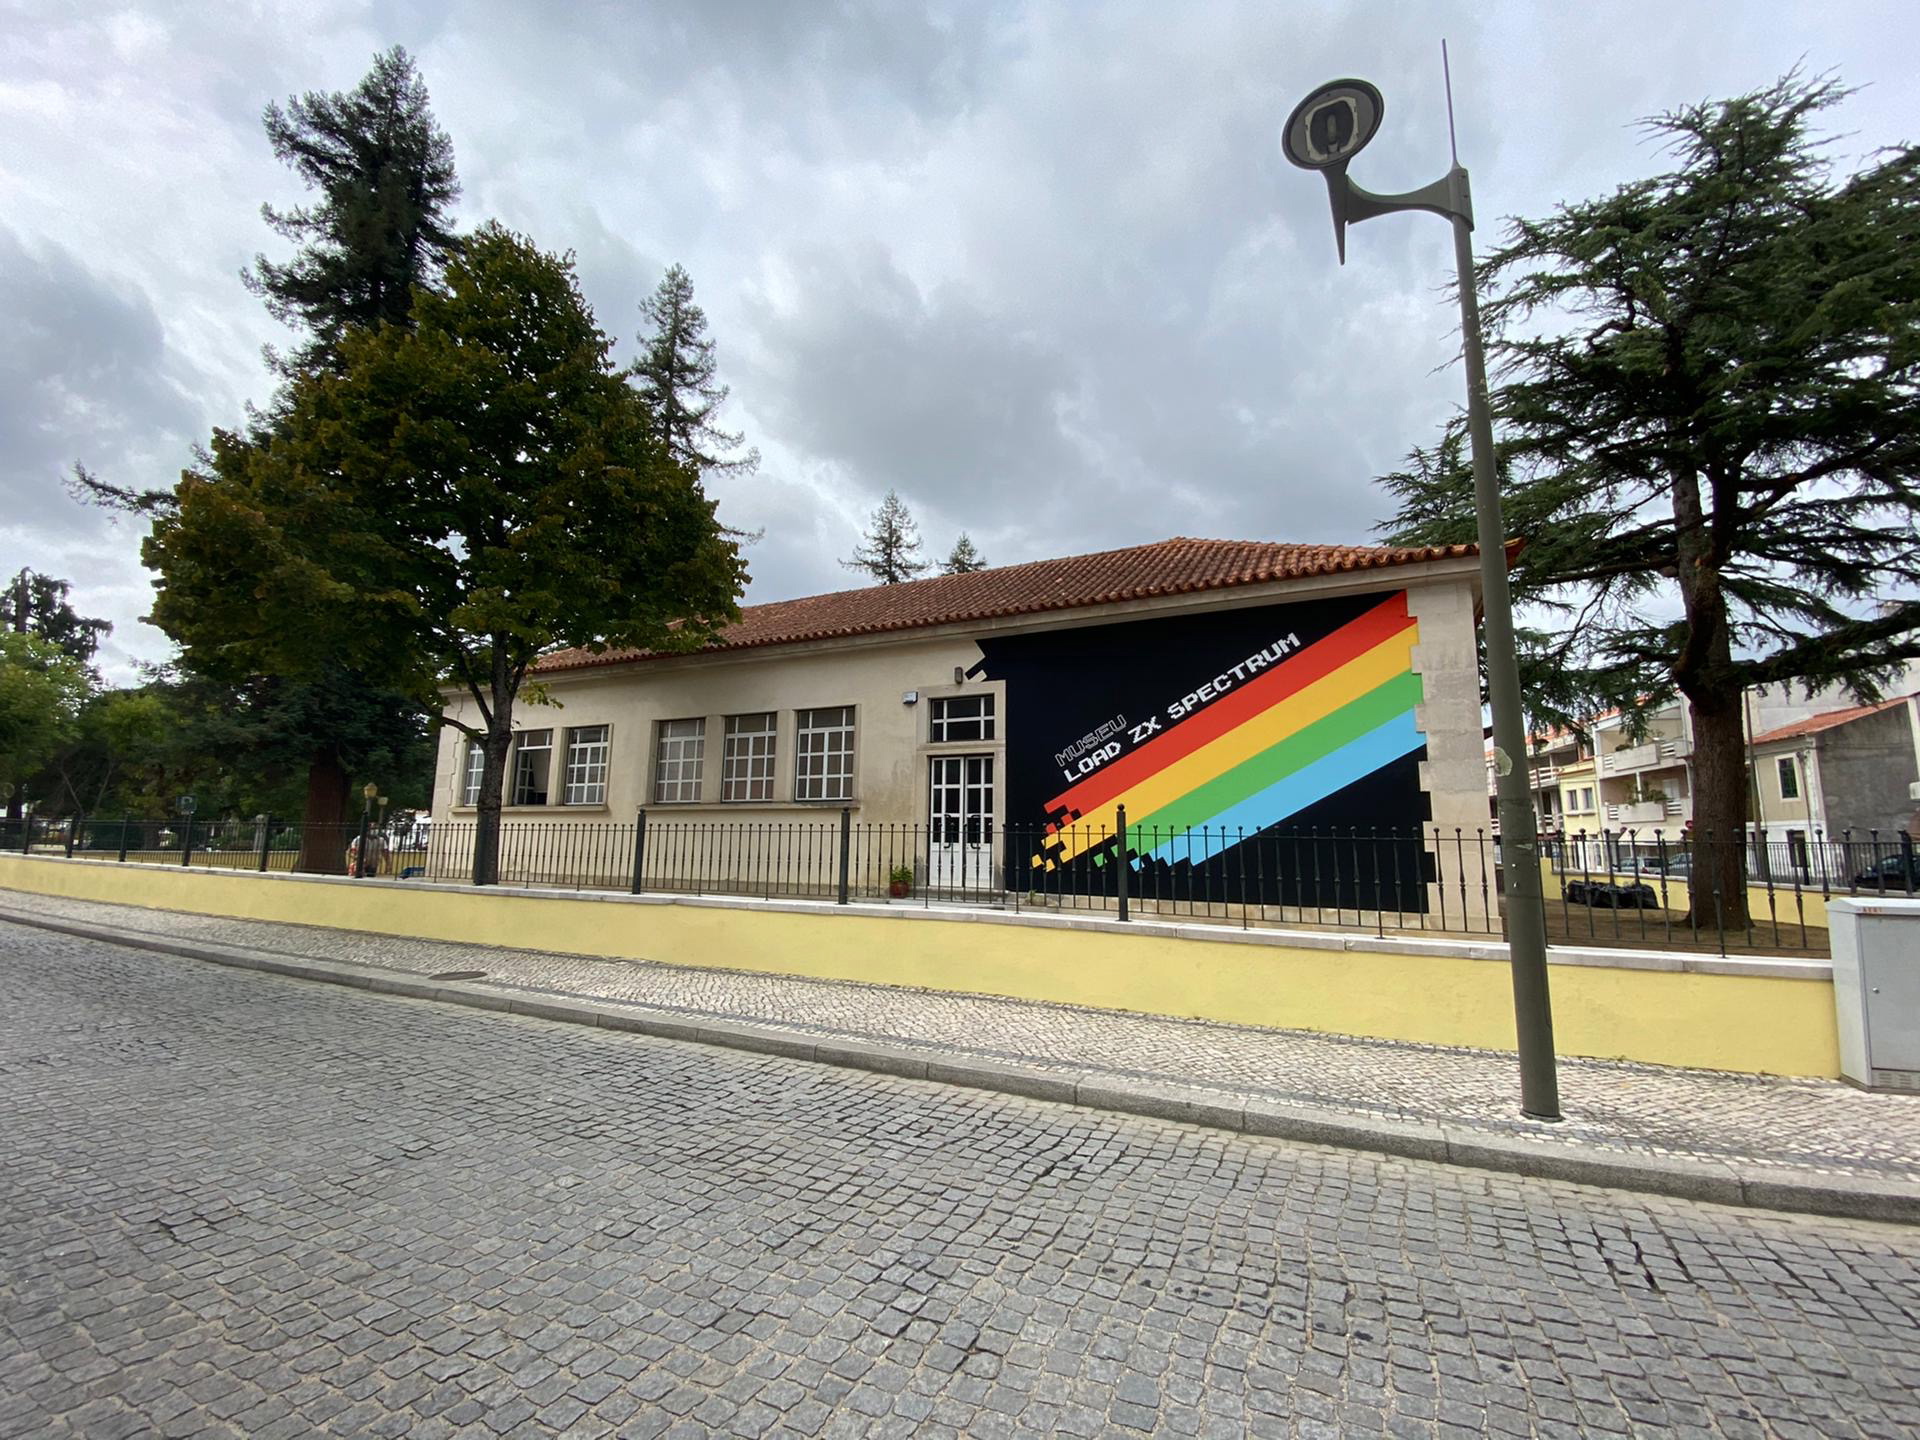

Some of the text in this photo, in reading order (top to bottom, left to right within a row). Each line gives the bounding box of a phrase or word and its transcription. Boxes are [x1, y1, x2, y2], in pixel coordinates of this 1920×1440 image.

[1055, 714, 1127, 767] MUSEU
[1063, 632, 1301, 783] LOAD ZX SPECTRUM
